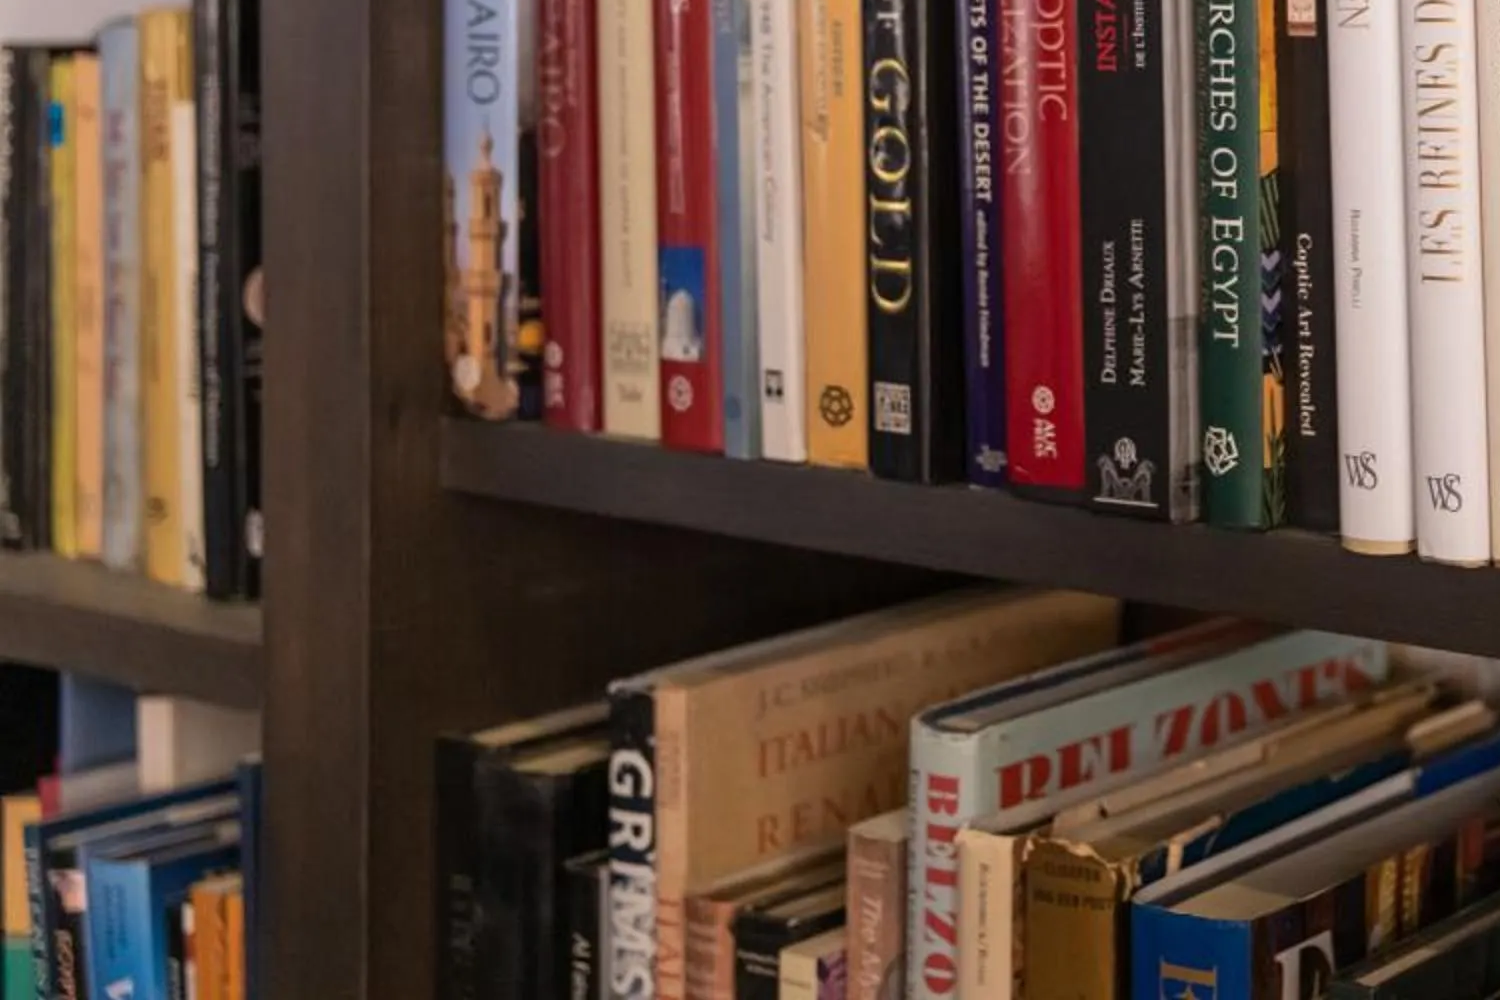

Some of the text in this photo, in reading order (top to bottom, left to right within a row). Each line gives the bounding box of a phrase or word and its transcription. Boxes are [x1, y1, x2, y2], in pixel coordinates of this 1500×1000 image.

[971, 36, 988, 65] OF
[972, 72, 989, 113] THE
[1416, 43, 1463, 191] REINES
[867, 57, 912, 314] GOLD
[974, 122, 992, 203] DESERT
[1209, 146, 1239, 200] OF
[1099, 240, 1117, 384] DELPHINE DRIAUX
[1126, 218, 1147, 387] MARIE-LYS ARNETTE
[1211, 215, 1245, 349] EGYPT
[1418, 209, 1464, 287] LES
[1295, 232, 1317, 437] Coptic Art Revealed
